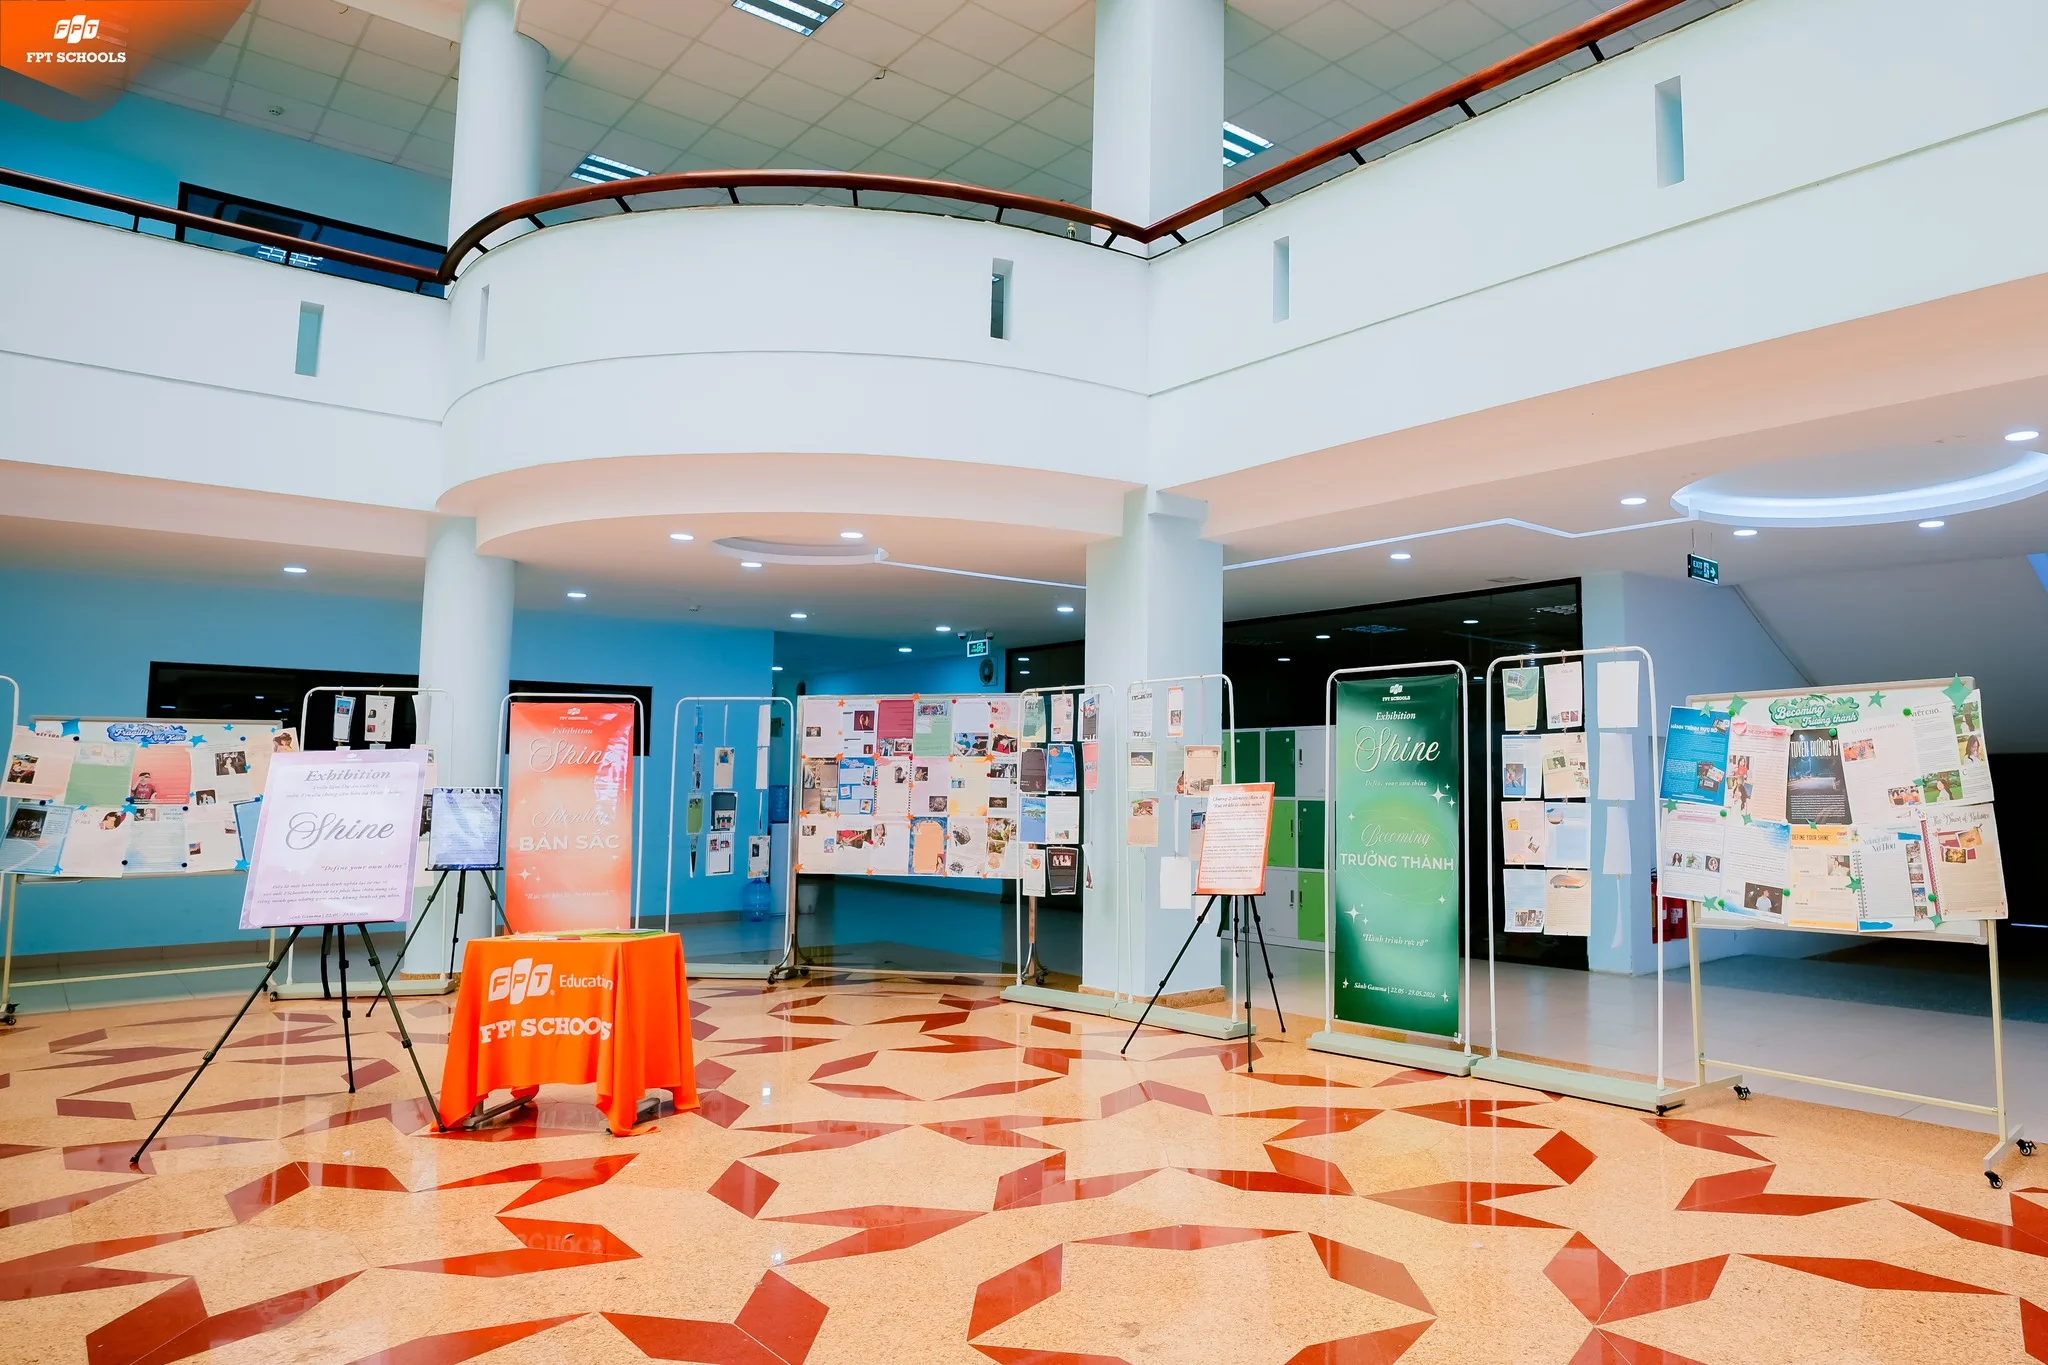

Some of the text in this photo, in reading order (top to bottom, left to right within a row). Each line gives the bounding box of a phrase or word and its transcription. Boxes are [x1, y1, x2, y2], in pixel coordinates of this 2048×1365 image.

[1376, 711, 1416, 720] Exhibition
[1775, 706, 1824, 719] Becoming
[1355, 725, 1440, 773] Shine
[304, 769, 392, 782] Exhibition
[285, 811, 395, 851] Shine
[519, 829, 621, 851] BẢN SẮC
[1361, 823, 1431, 848] Becoming
[1340, 850, 1454, 871] TRƯỞNG THÀNH
[488, 958, 613, 1005] FPT Educatin
[521, 1017, 613, 1041] SCHOOS
